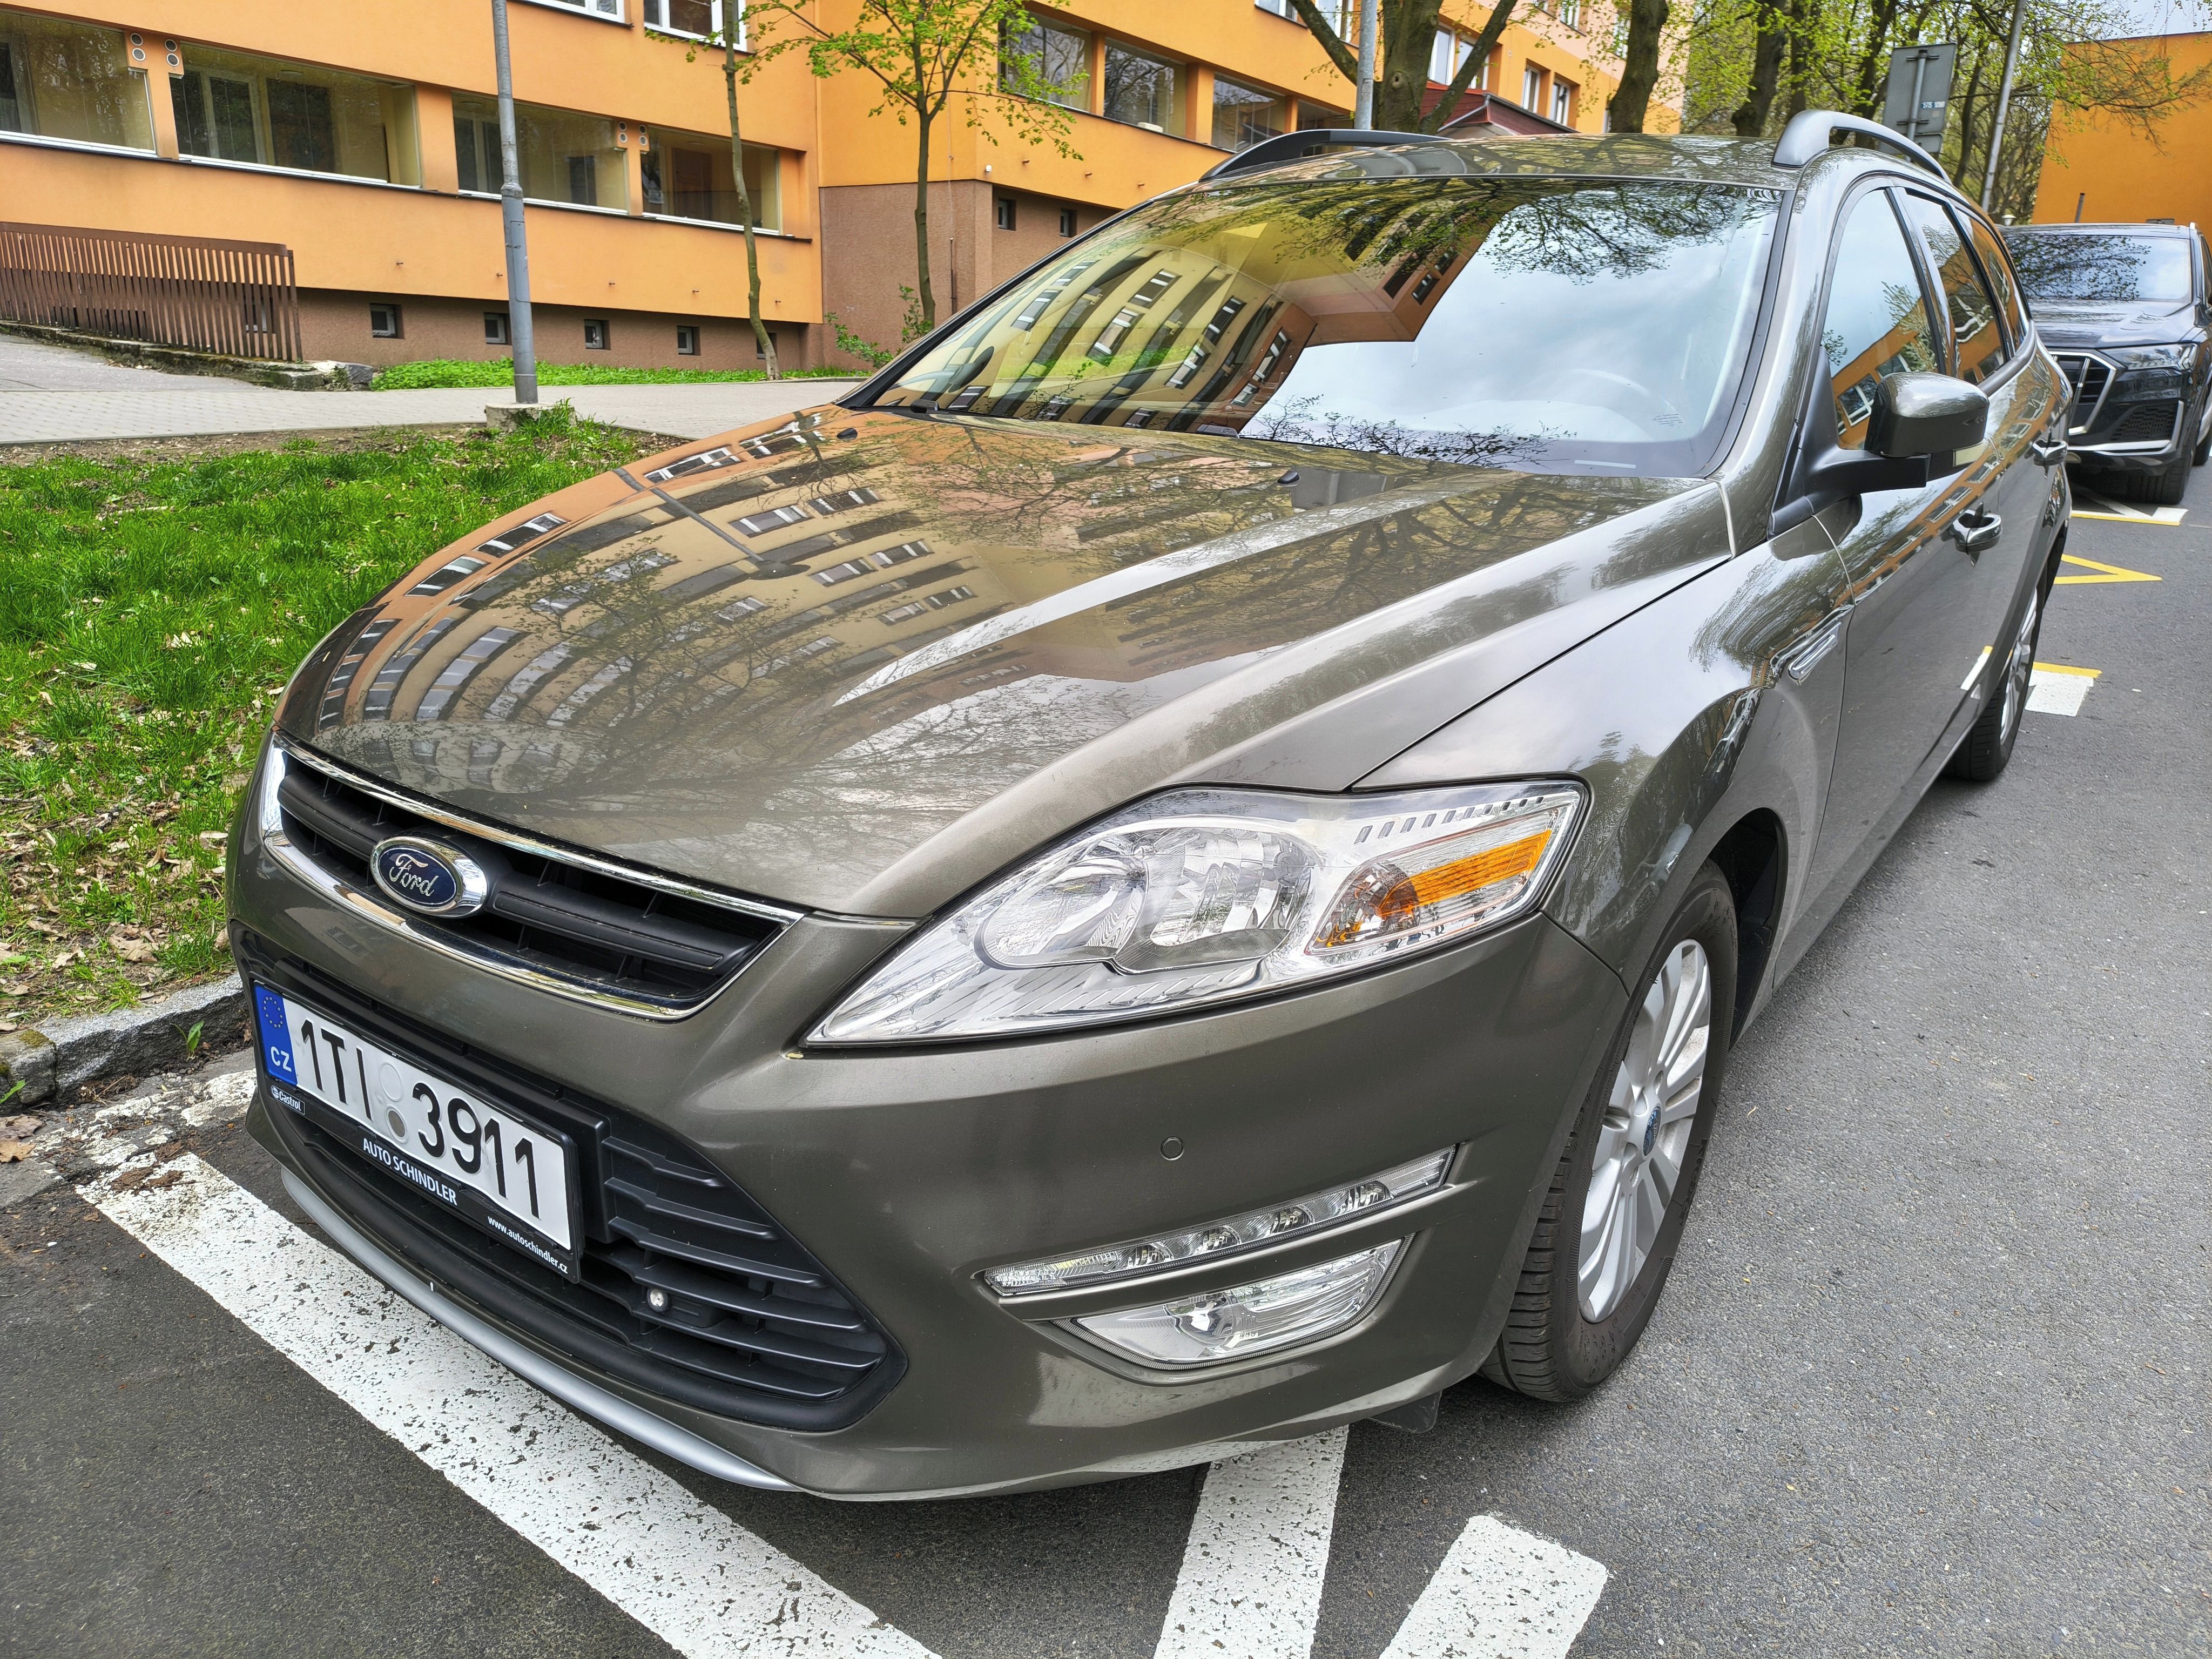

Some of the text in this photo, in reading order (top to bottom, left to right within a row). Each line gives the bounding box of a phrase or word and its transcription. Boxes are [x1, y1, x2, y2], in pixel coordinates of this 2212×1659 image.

[389, 853, 439, 896] Ford
[271, 1046, 292, 1072] CZ
[279, 1091, 301, 1111] Castrol
[301, 1019, 541, 1219] 1TI 3911
[363, 1138, 457, 1205] AUTO SCHINDLER
[488, 1216, 568, 1273] www.autoschindler.cz
